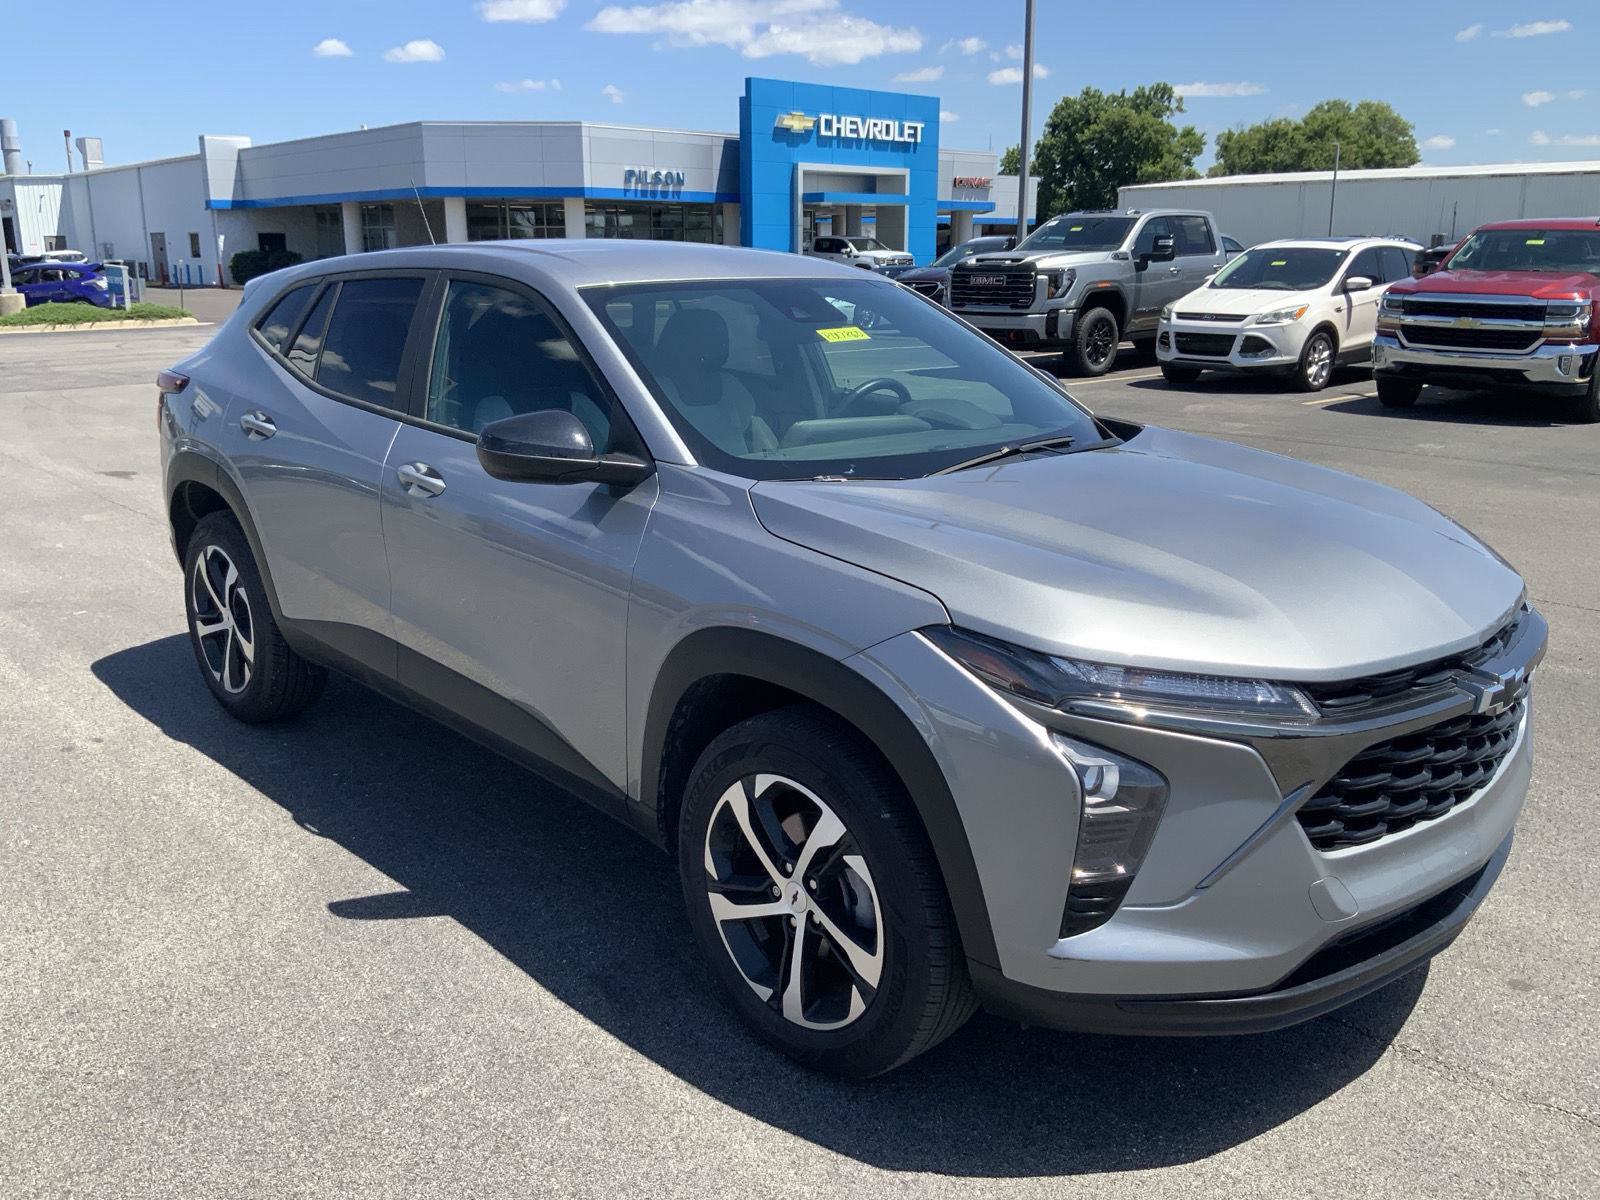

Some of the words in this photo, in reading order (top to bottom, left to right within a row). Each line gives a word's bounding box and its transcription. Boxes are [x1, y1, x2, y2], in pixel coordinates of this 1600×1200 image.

[820, 114, 925, 143] CHEVROLET
[623, 168, 685, 187] PILSON
[972, 275, 1004, 285] GMC
